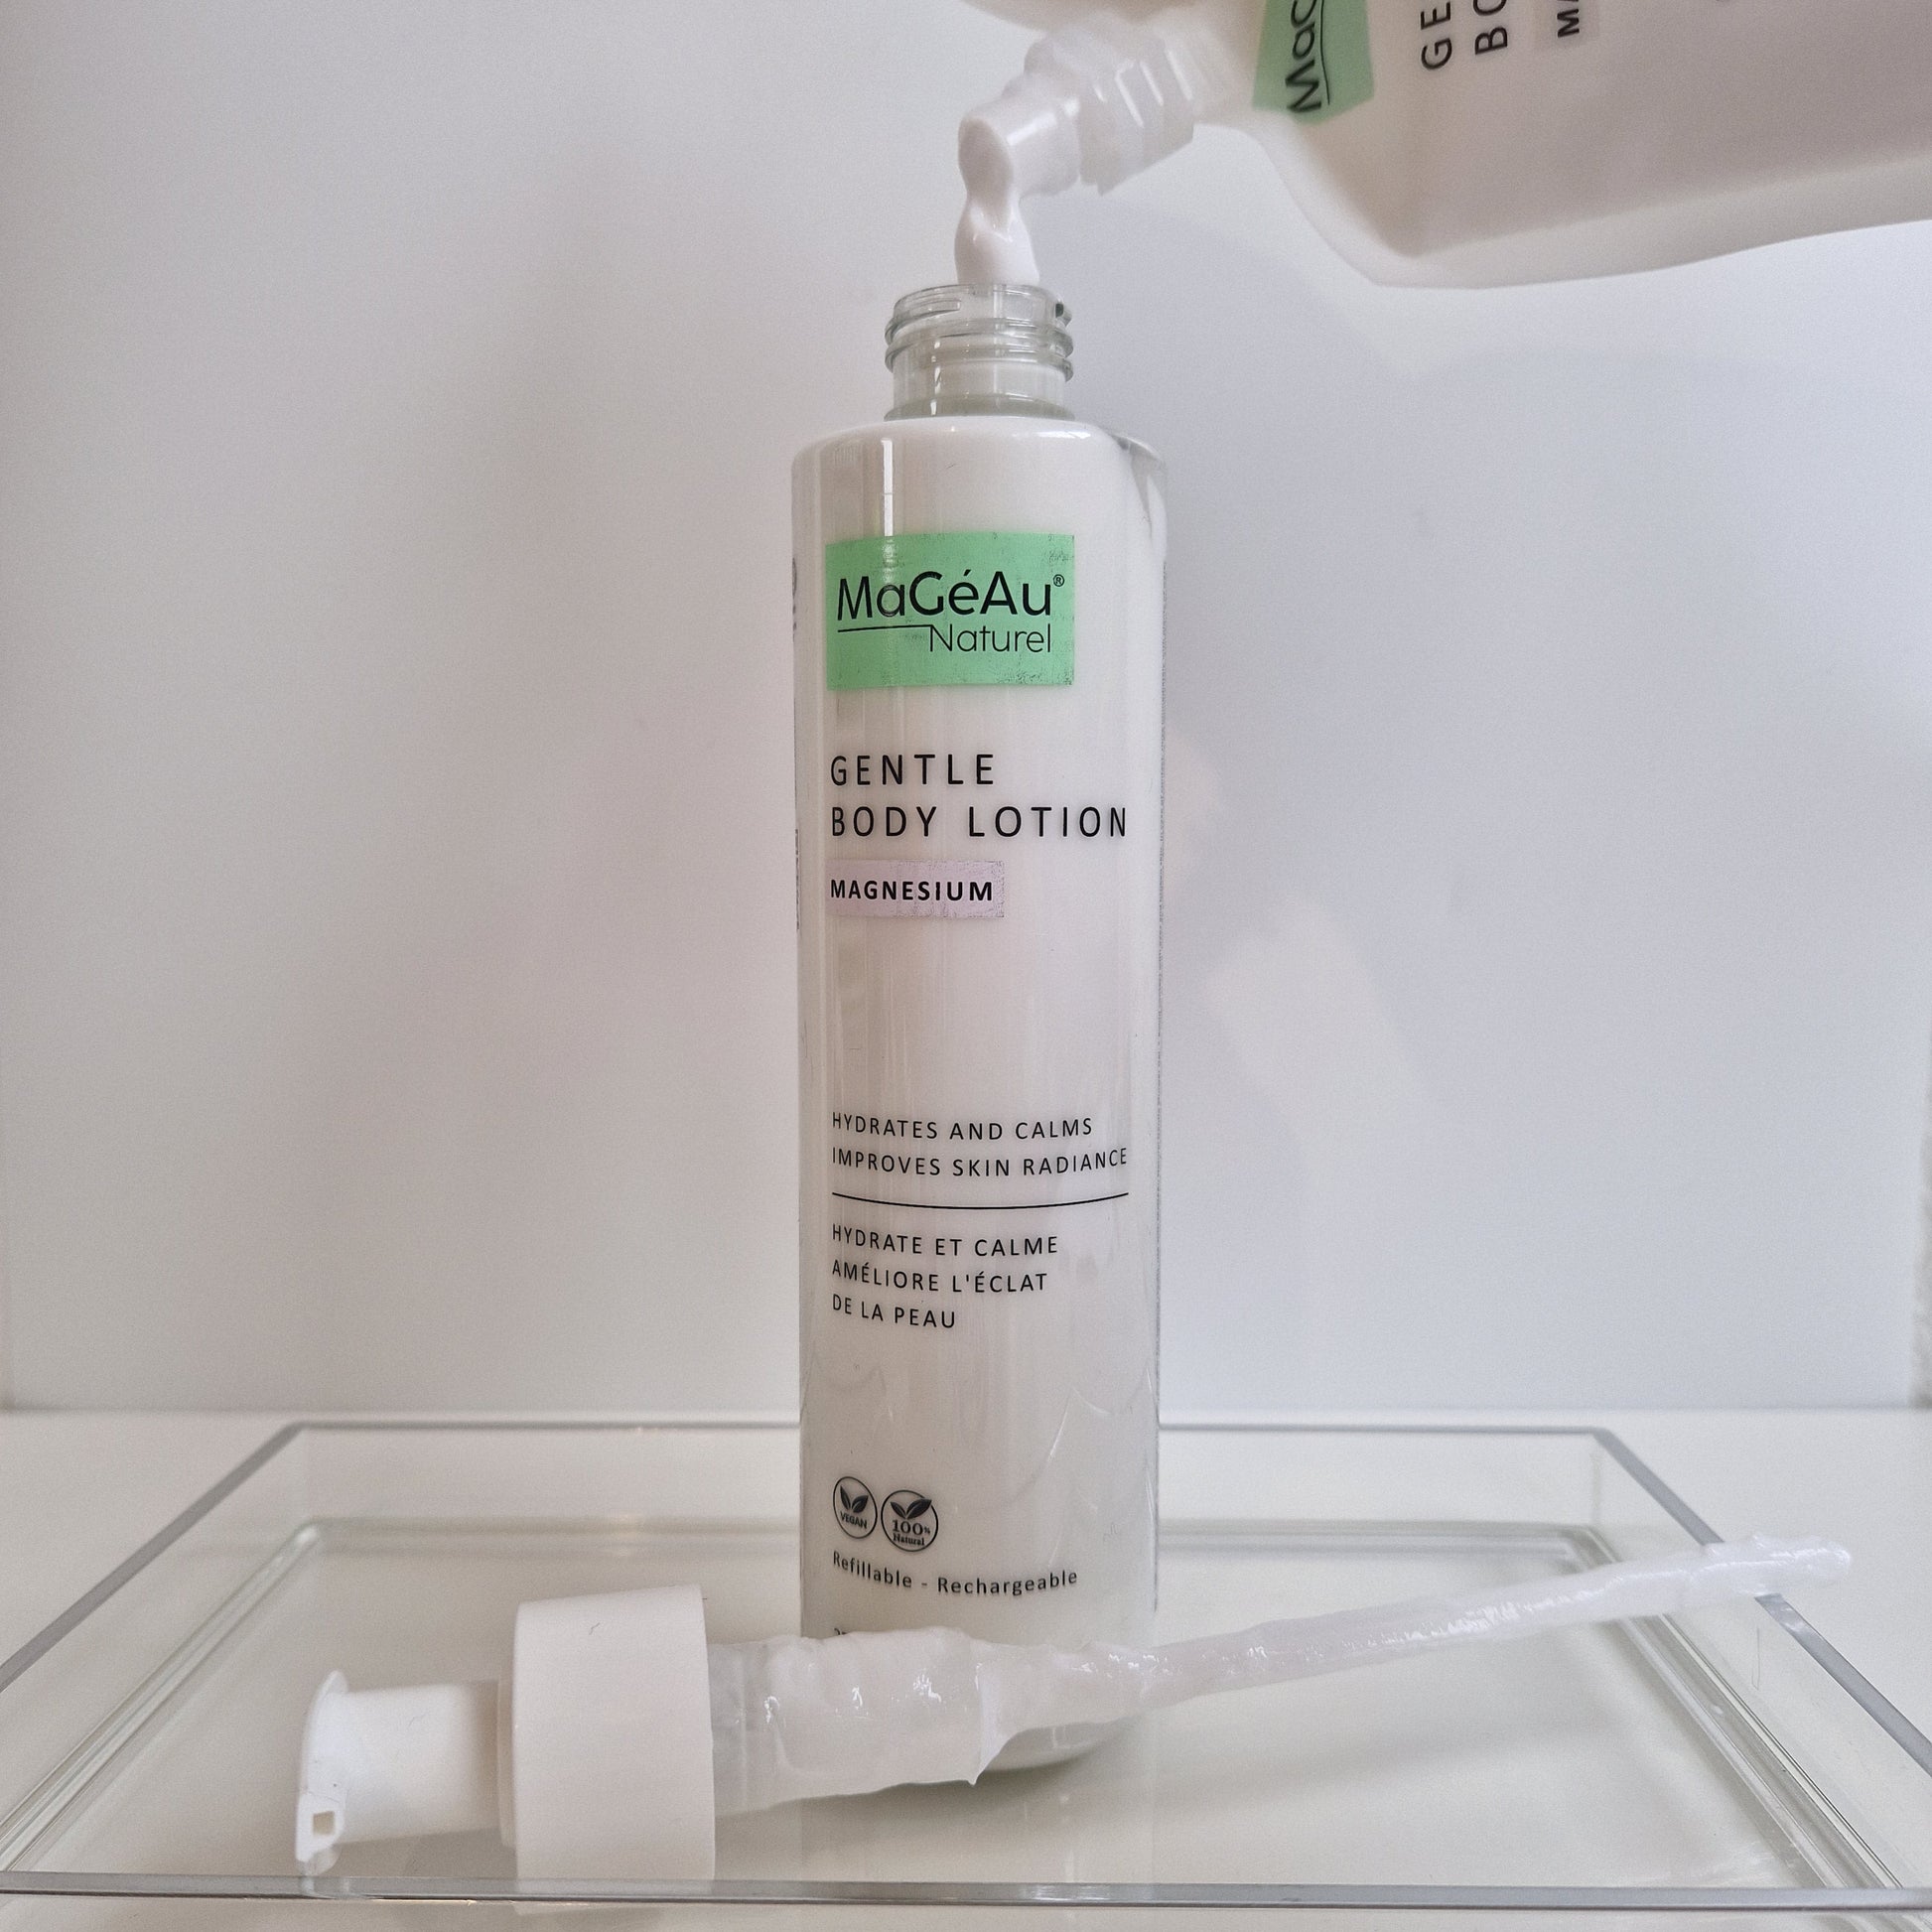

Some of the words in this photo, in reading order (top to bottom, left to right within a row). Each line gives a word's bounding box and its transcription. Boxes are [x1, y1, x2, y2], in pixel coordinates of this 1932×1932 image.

[927, 623, 1051, 653] Naturel
[830, 754, 994, 786] GENTLE
[831, 806, 937, 837] BODY
[968, 806, 1127, 837] LOTION
[830, 879, 993, 901] MAGNESIUM
[832, 1112, 938, 1140] HYDRATES
[949, 1122, 1004, 1140] AND
[1015, 1117, 1093, 1140] CALMS
[832, 1147, 941, 1175] IMPROVES
[952, 1159, 1011, 1176] SKIN
[1023, 1148, 1128, 1175] RADIANCE
[832, 1223, 923, 1255] HYDRATE
[935, 1237, 963, 1256] ET
[974, 1236, 1058, 1257] CALME
[832, 1259, 939, 1291] AMÉLIORE
[952, 1271, 1048, 1293] L'ÉCLAT
[832, 1293, 853, 1315] DE
[861, 1301, 884, 1321] LA
[895, 1307, 956, 1328] PEAU
[840, 1511, 868, 1529] VEGAN
[894, 1534, 925, 1547] Natural
[833, 1550, 912, 1588] Refillable
[937, 1570, 1078, 1596] Rechargeable
